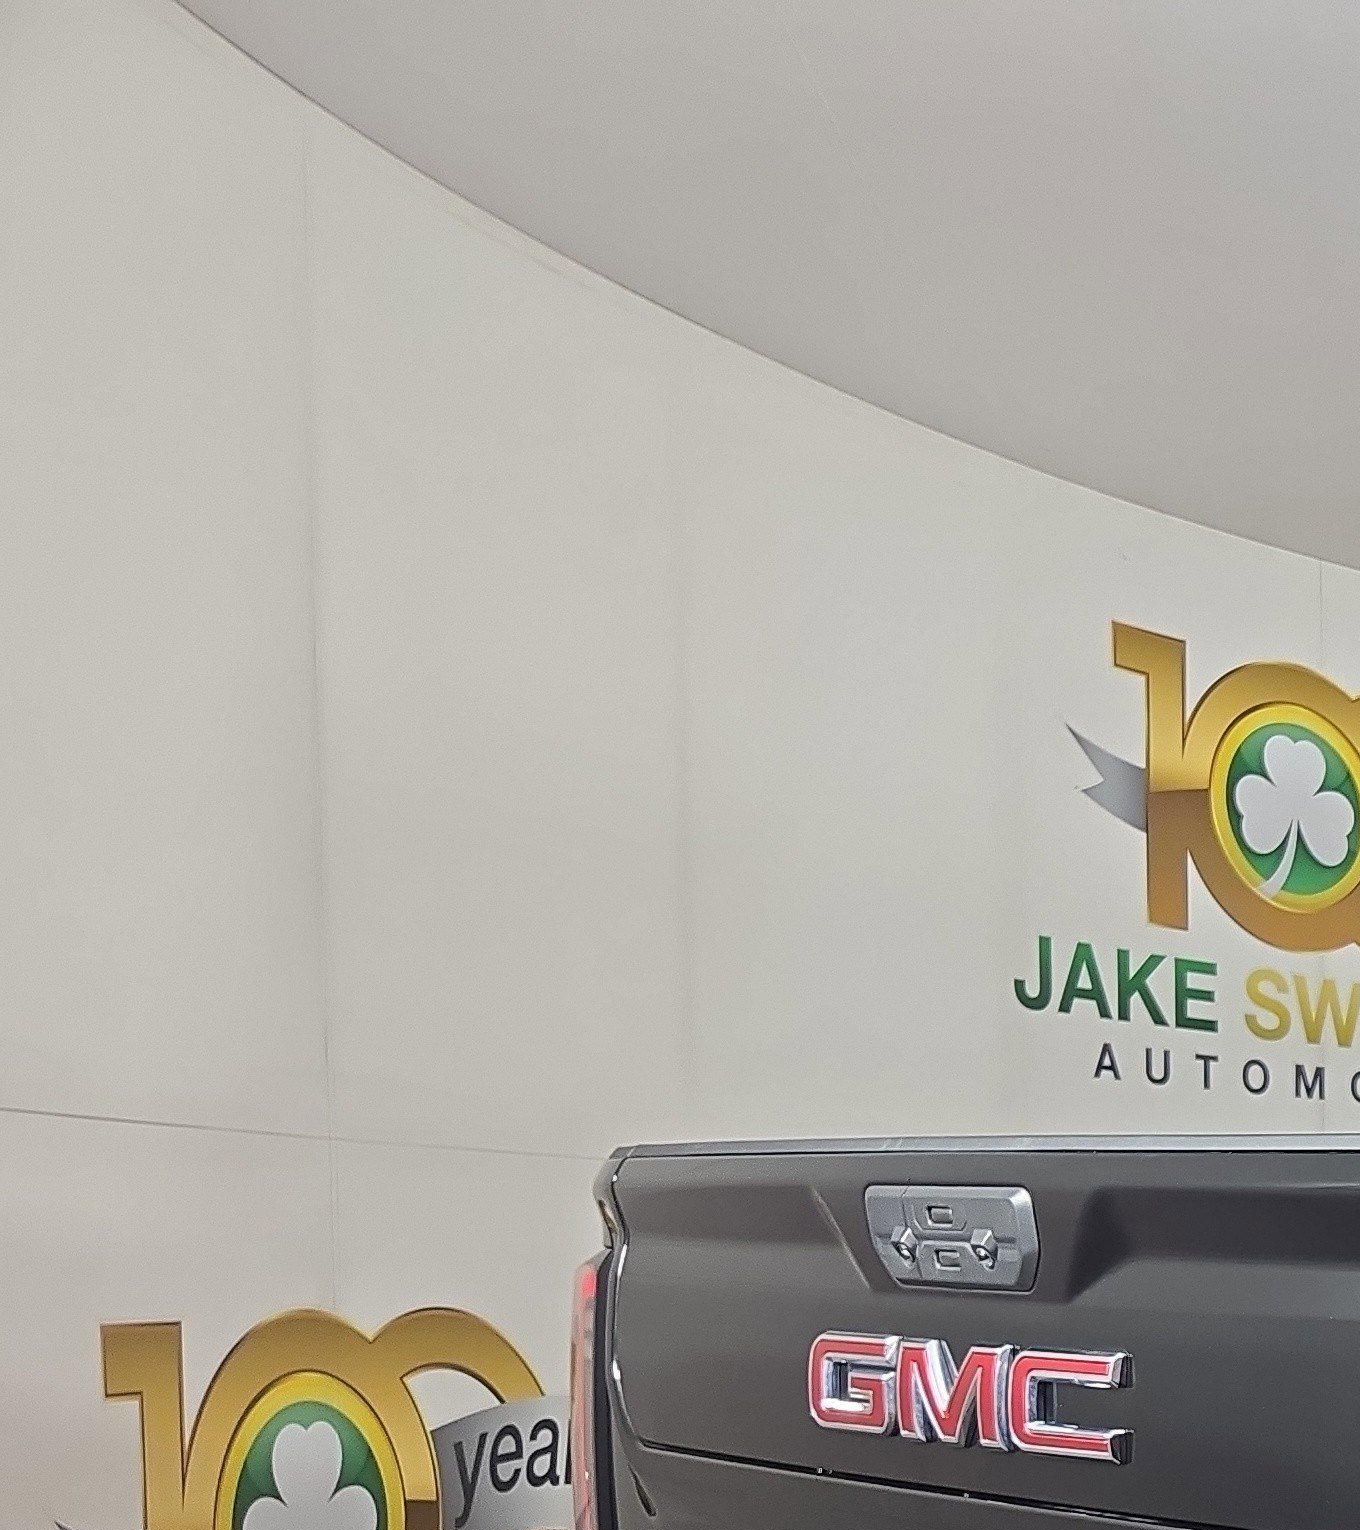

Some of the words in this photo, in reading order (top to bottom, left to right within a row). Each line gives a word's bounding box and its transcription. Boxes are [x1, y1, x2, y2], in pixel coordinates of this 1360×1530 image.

[1013, 935, 1219, 1033] JAKE
[807, 1330, 1136, 1465] GMC
[453, 1417, 572, 1528] yea
